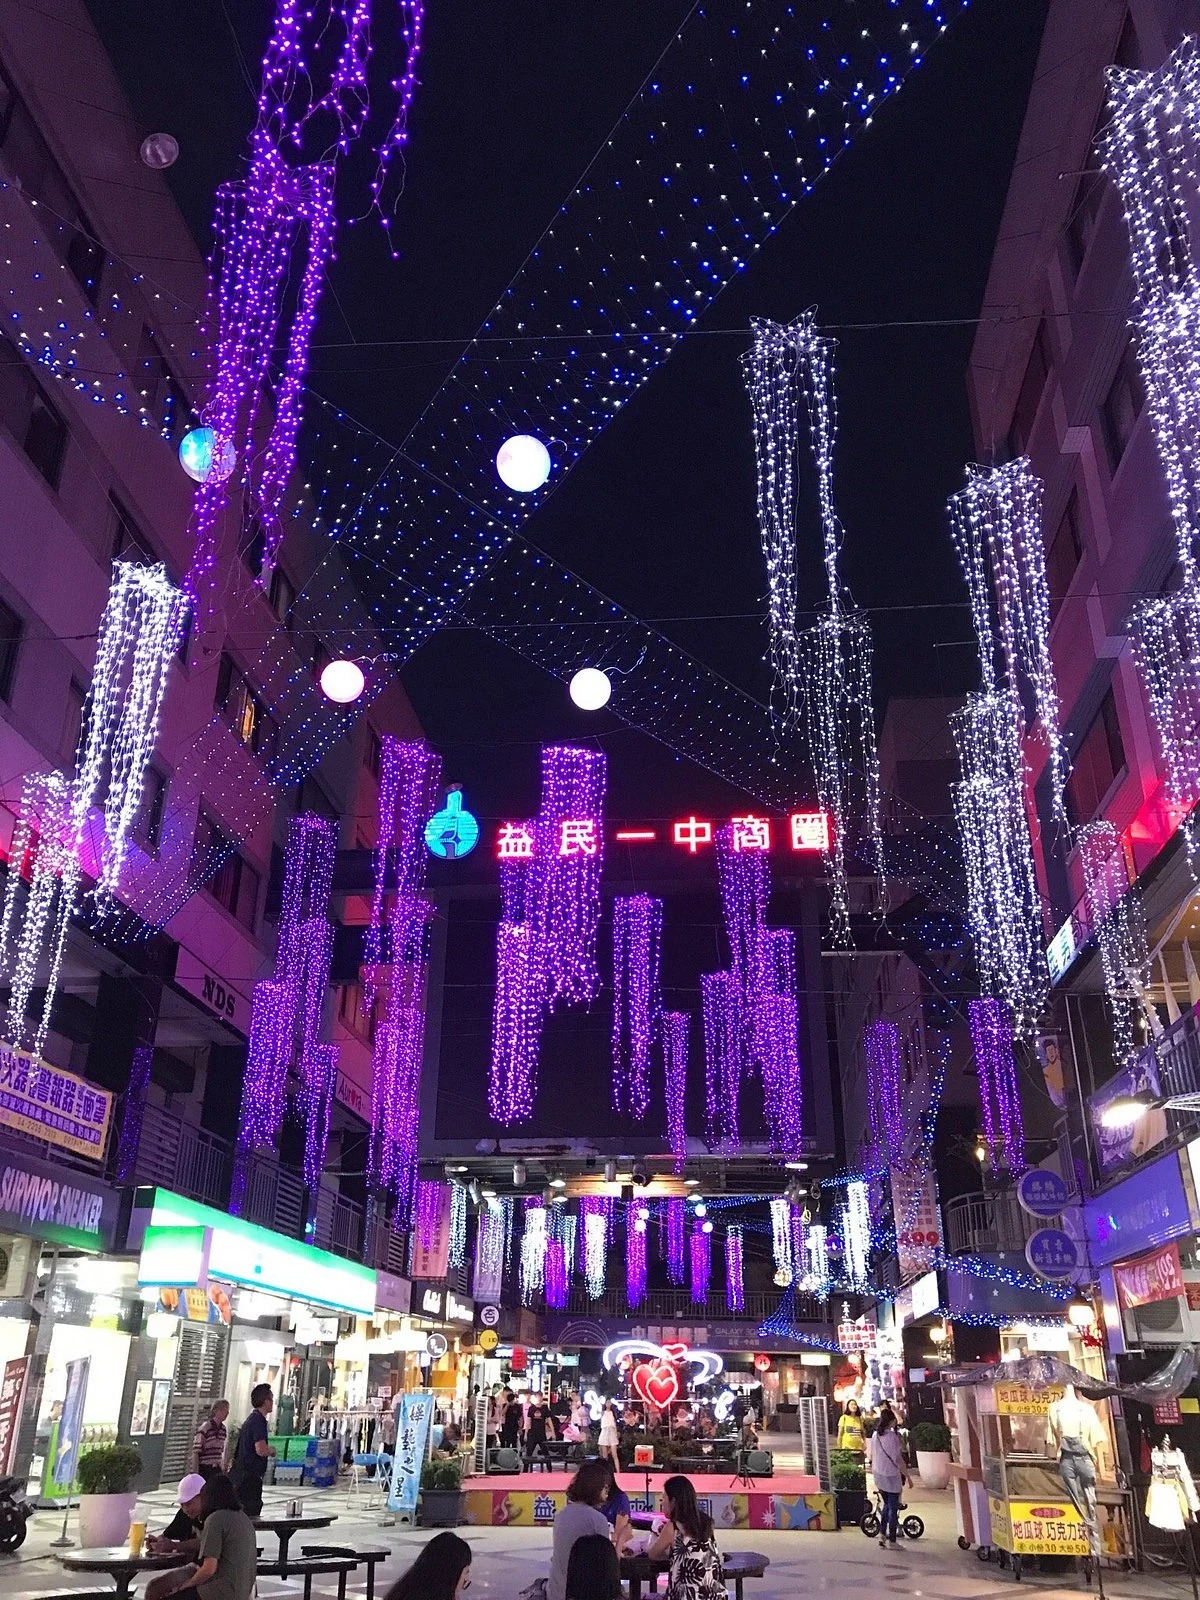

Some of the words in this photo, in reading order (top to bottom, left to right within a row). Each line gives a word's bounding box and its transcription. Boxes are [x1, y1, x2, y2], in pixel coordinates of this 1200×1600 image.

[497, 813, 829, 858] 益民一中商圈
[202, 974, 235, 1018] NDS
[0, 1166, 60, 1228] SURVIVOR
[56, 1184, 103, 1235] SNEAKER
[999, 1389, 1029, 1404] 地瓜球
[1031, 1391, 1064, 1404] 巧克力
[1012, 1520, 1044, 1540] 地瓜球
[1045, 1521, 1089, 1541] 巧克力球
